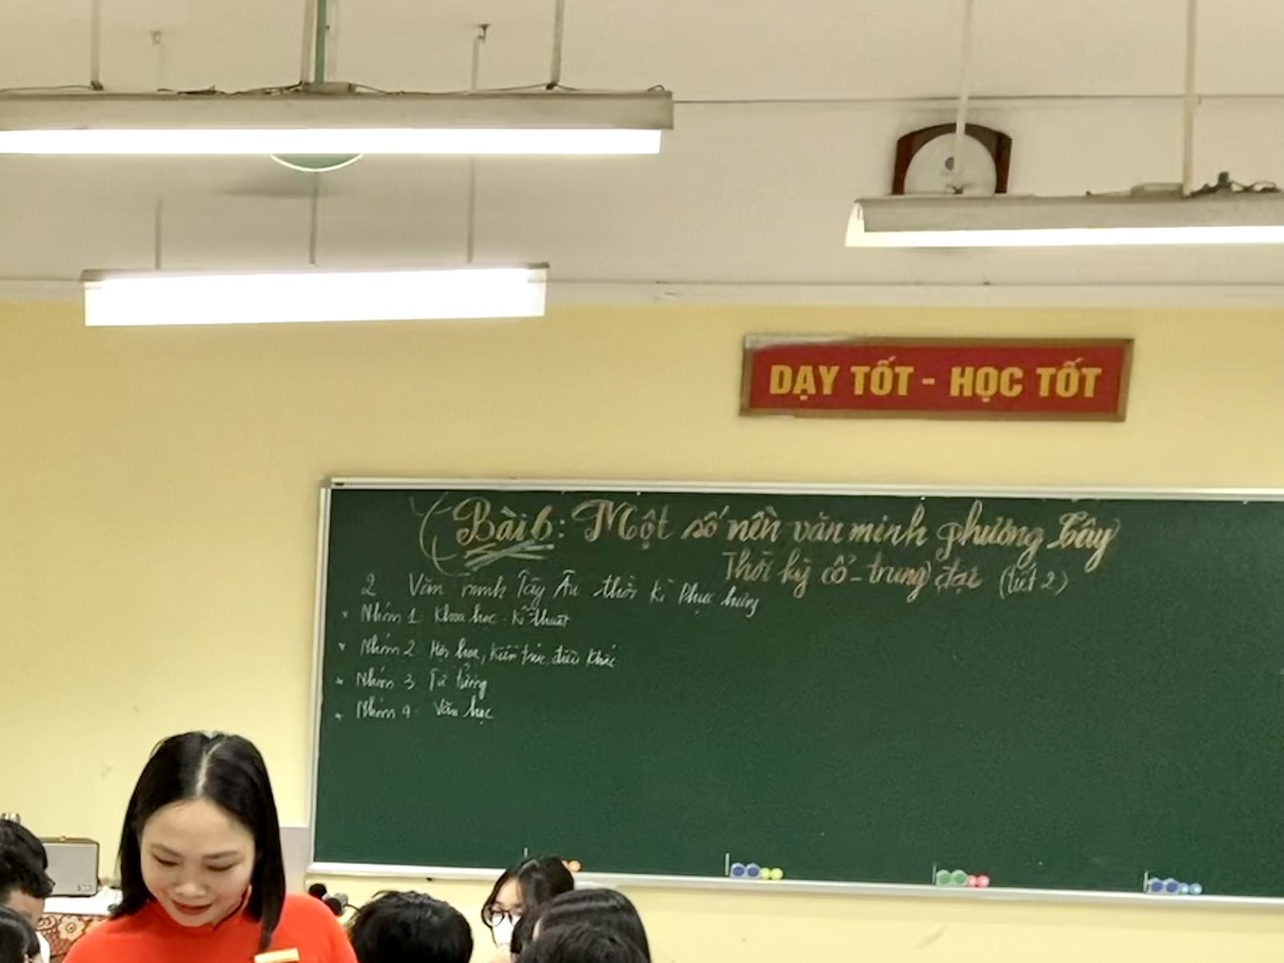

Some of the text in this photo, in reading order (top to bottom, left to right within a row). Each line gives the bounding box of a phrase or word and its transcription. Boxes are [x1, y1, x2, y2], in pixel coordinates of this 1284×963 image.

[770, 365, 839, 401] DẠY
[851, 356, 914, 396] TỐT
[950, 366, 1023, 402] HỌC
[1037, 357, 1102, 398] TỐT
[571, 499, 674, 550] Một
[680, 505, 729, 540] số
[727, 506, 782, 542] nền
[792, 511, 843, 543] văn
[849, 503, 929, 547] minh
[868, 552, 931, 603] trung
[361, 601, 402, 624] Nhóm
[359, 632, 400, 656] Nhóm
[356, 667, 395, 690] Nhóm
[403, 672, 416, 691] 3
[356, 696, 396, 720] Nhóm
